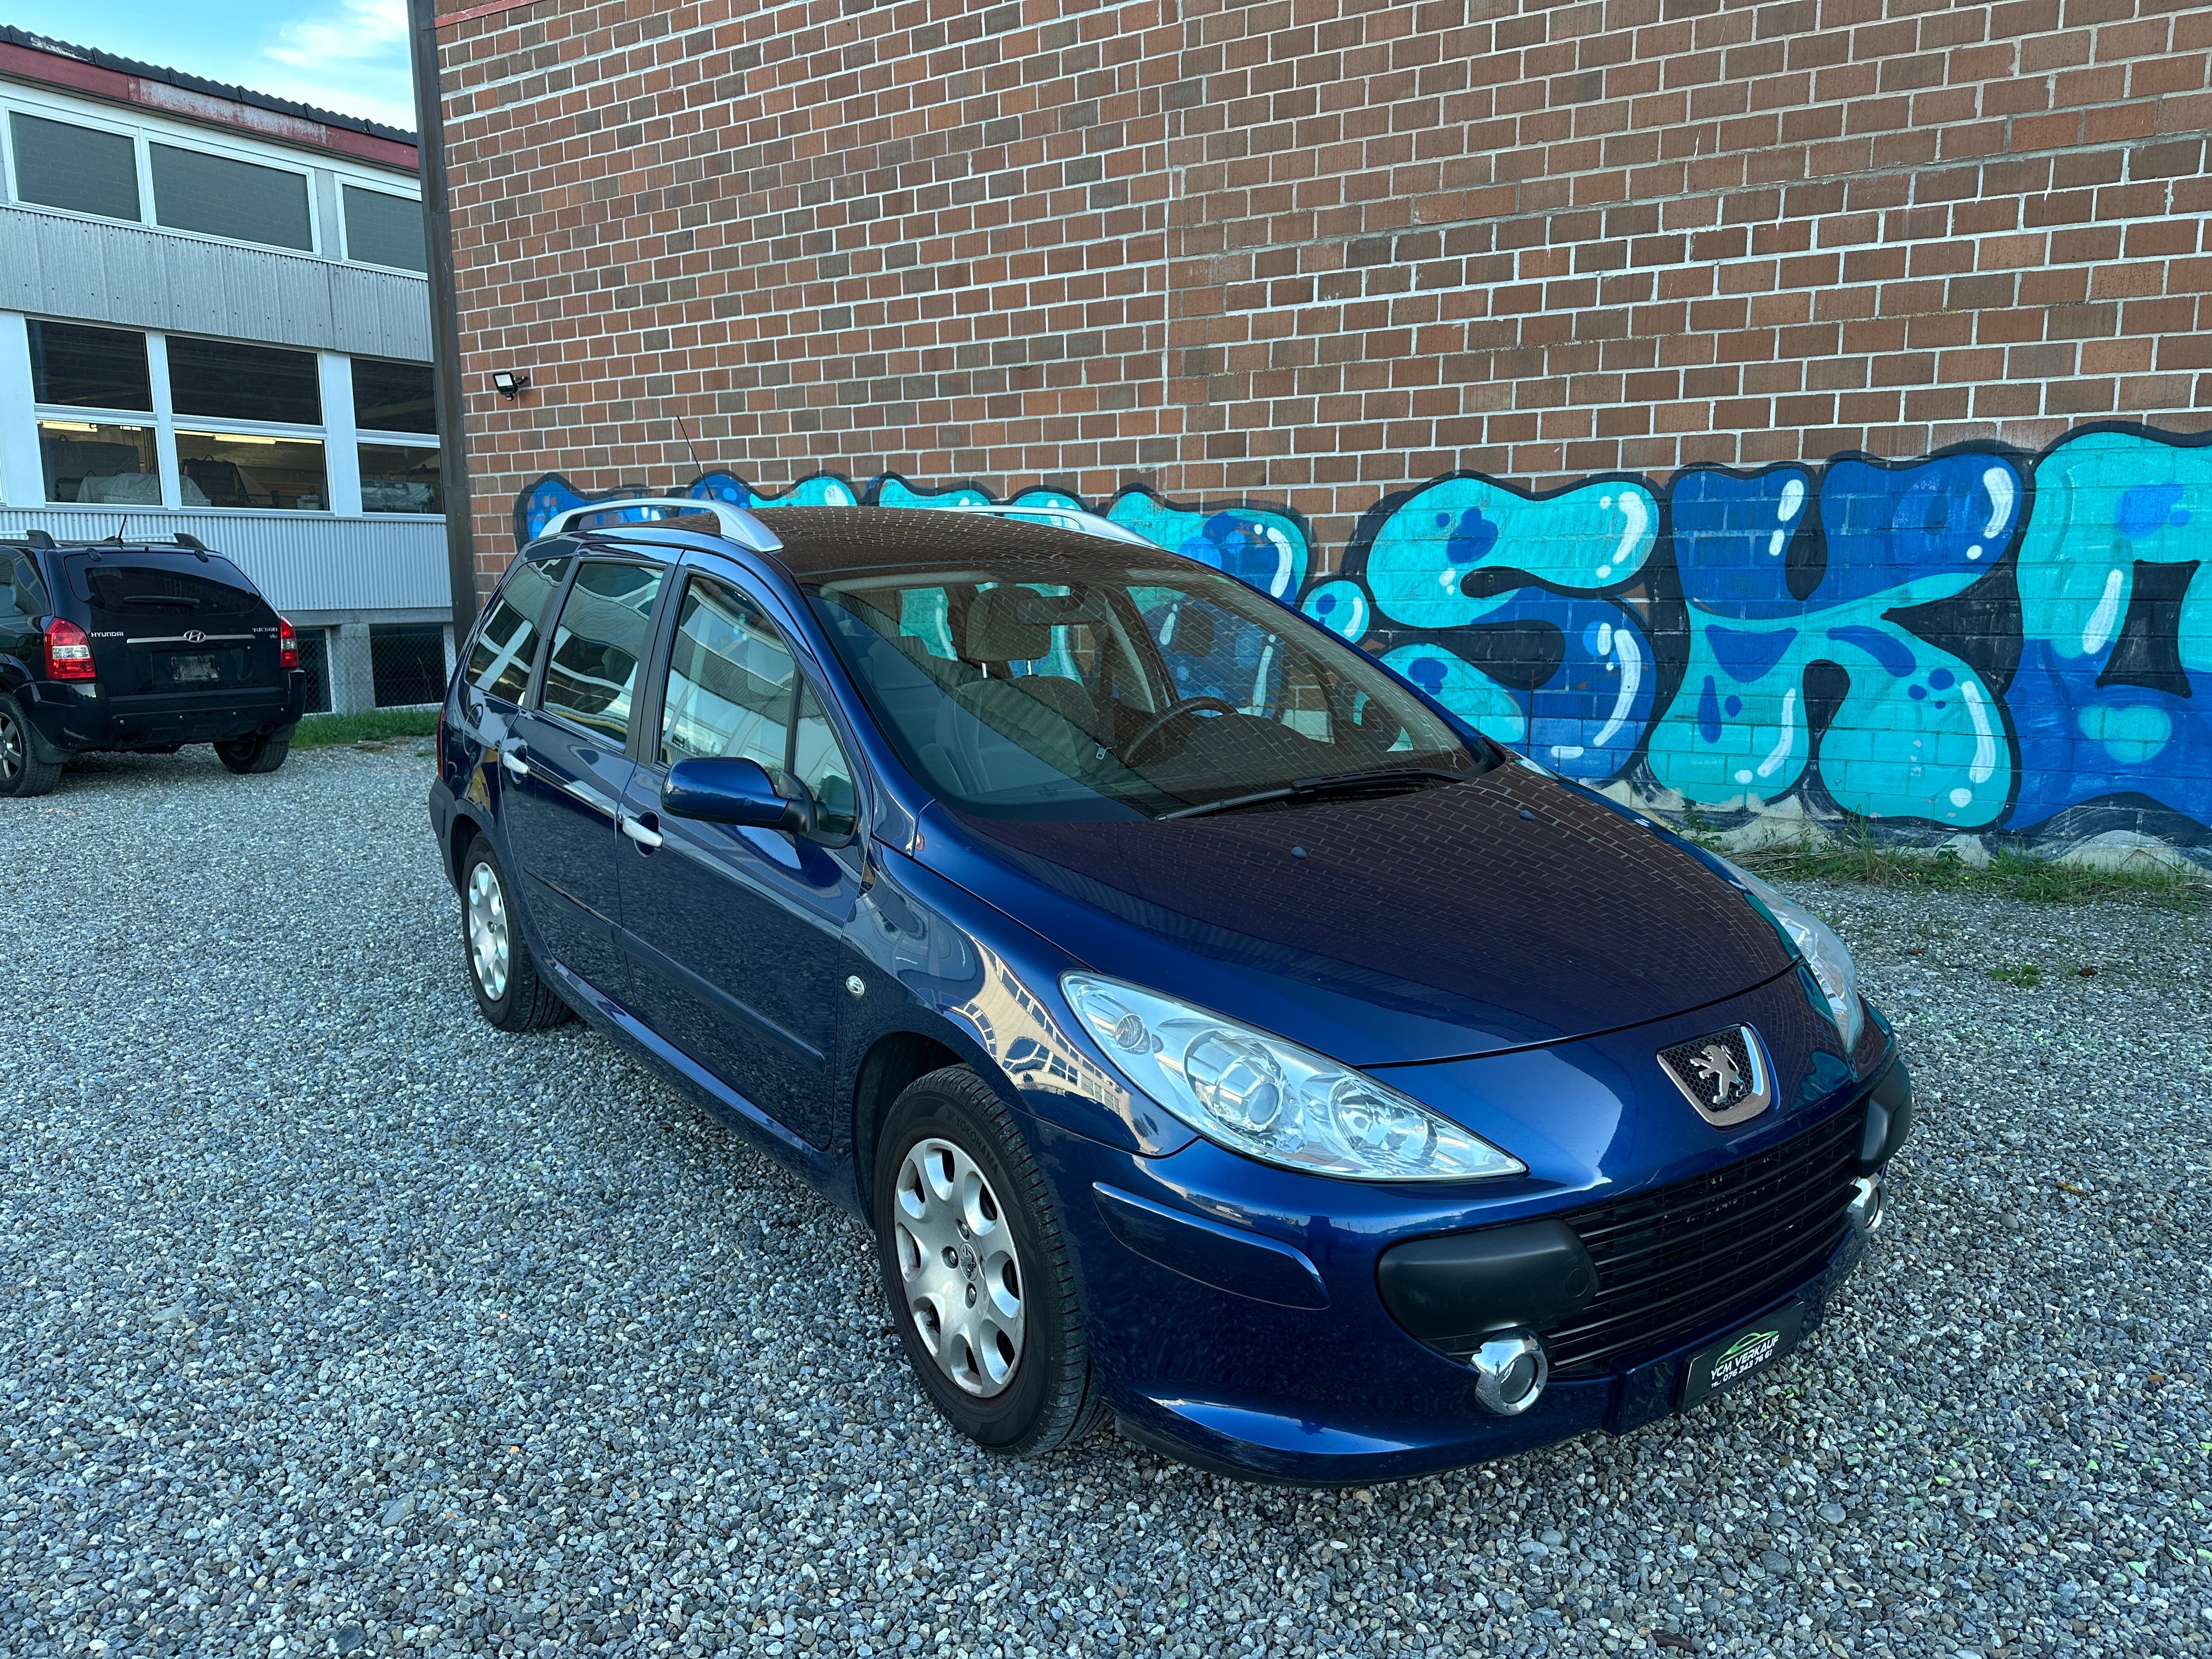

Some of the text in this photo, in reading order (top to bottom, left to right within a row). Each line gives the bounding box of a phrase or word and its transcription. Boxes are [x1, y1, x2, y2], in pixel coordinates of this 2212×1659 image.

[956, 1115, 998, 1175] YOKOHAMA
[1711, 1334, 1780, 1380] YCM VERKAUF
[1723, 1368, 1738, 1382] 076
[1739, 1359, 1753, 1374] 343
[1754, 1354, 1764, 1365] 76
[1764, 1348, 1773, 1359] 61
